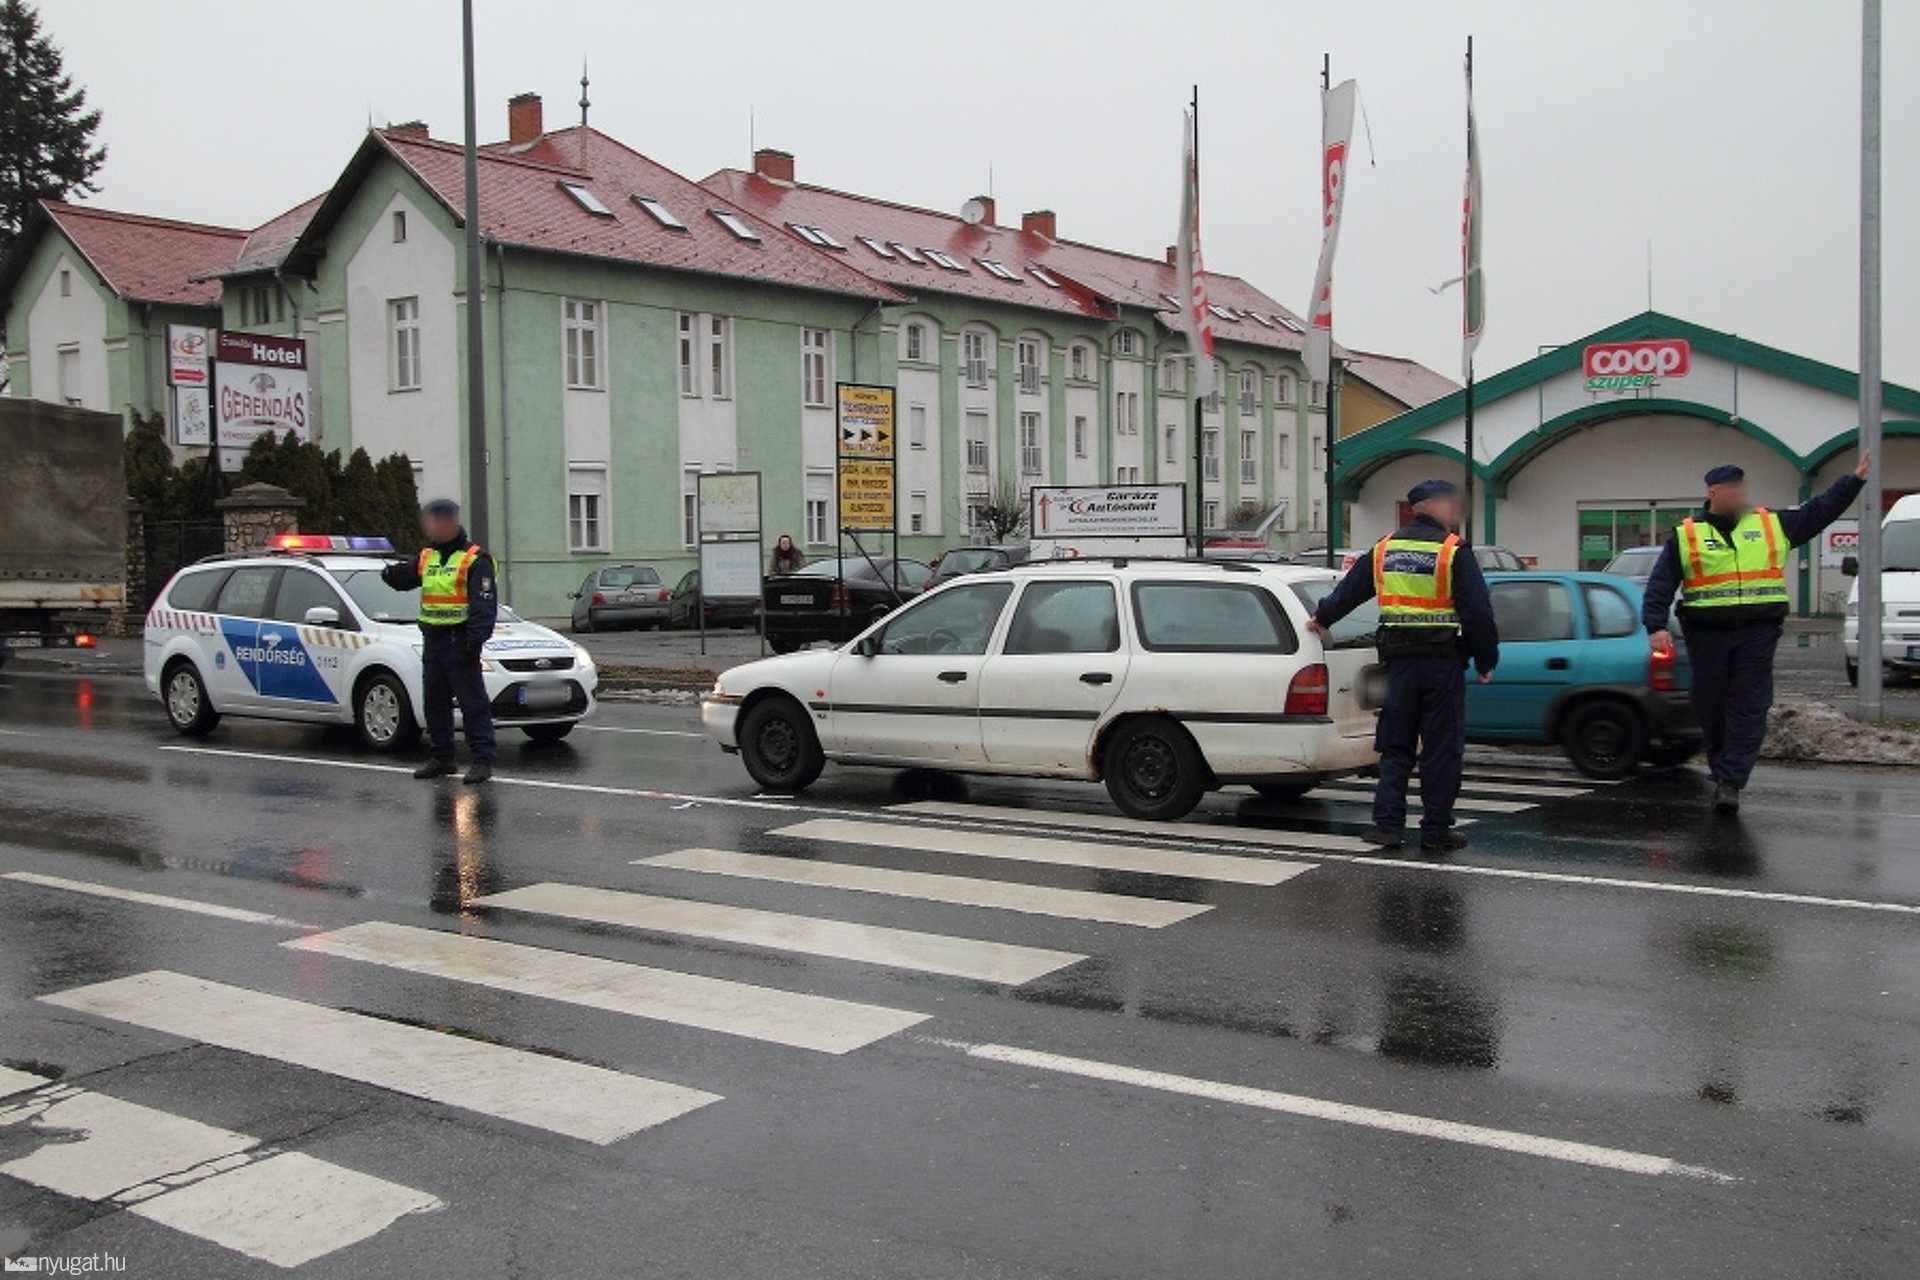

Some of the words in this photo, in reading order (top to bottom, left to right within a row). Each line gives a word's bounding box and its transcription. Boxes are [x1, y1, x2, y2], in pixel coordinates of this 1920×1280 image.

[253, 343, 302, 364] Hotel
[1591, 347, 1681, 376] coop
[221, 386, 306, 428] GERENDÁS
[236, 646, 306, 666] RENDŐRSÉG
